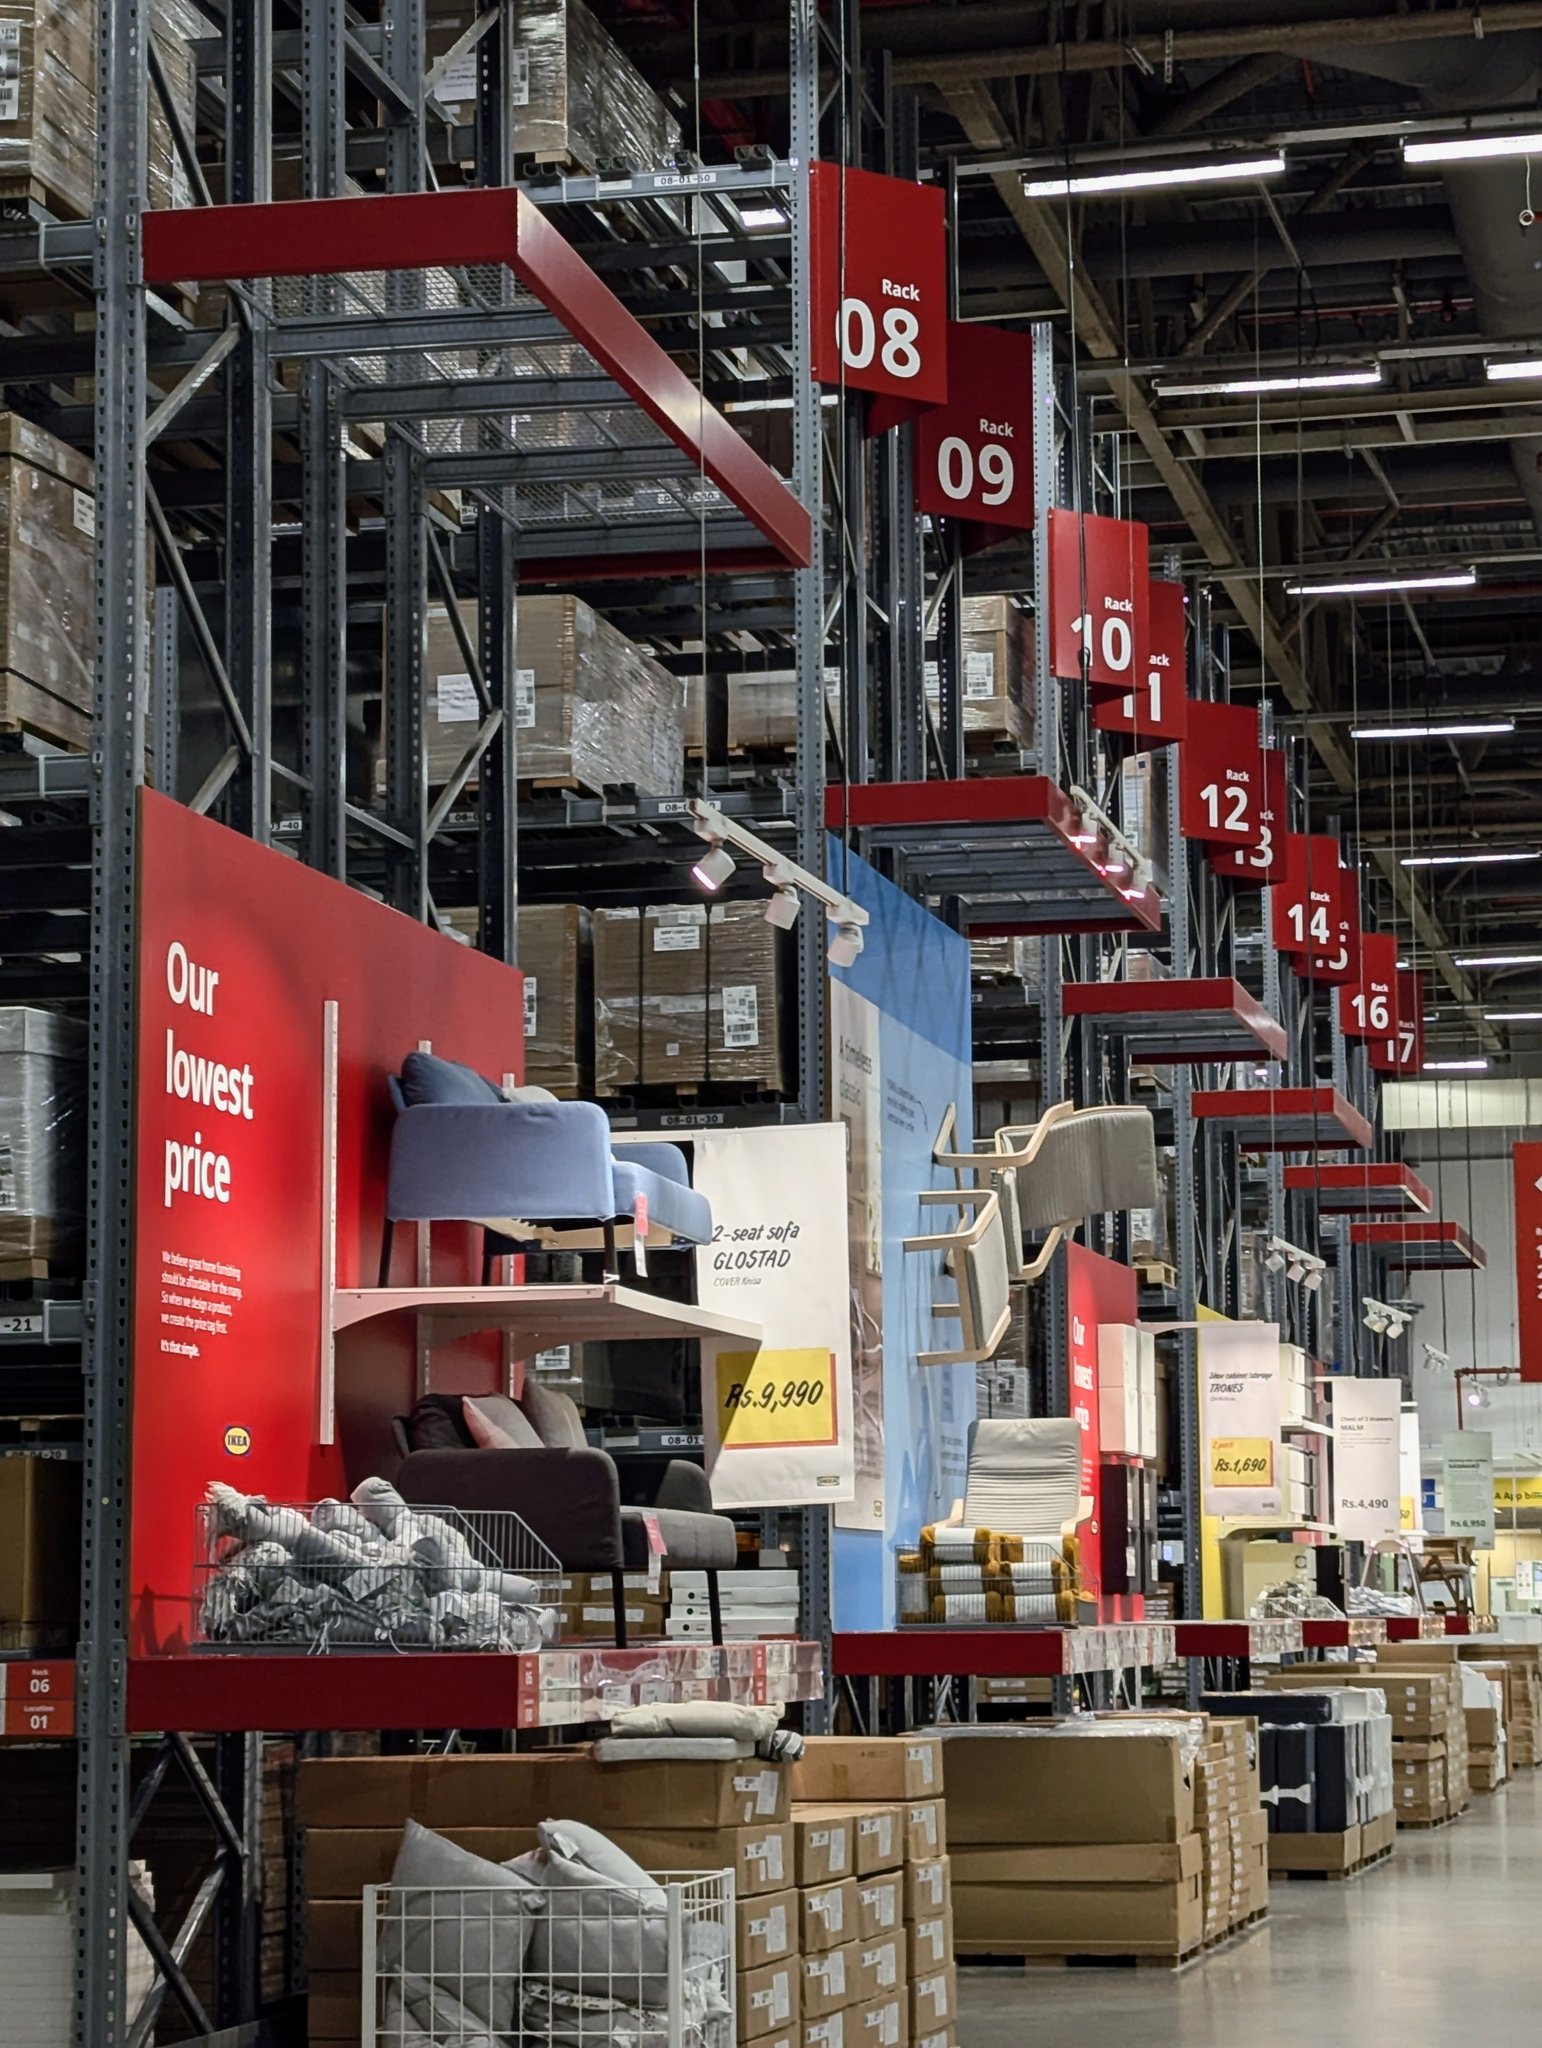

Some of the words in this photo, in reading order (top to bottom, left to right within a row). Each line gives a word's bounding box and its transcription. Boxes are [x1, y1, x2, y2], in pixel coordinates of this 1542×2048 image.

[881, 277, 921, 302] Rack
[835, 297, 921, 379] 08
[979, 418, 1014, 438] Rack
[937, 436, 1014, 506] 09
[1104, 596, 1133, 613] Rack
[1070, 614, 1132, 672] 10
[1149, 653, 1170, 667] ack
[1226, 769, 1250, 783] Rack
[1200, 784, 1249, 832] 12
[1310, 891, 1331, 903] Rack
[1287, 903, 1331, 945] 14
[166, 941, 219, 1017] Our
[1371, 982, 1389, 993] Rack
[1351, 994, 1389, 1030] 16
[1387, 1032, 1415, 1064] 17
[165, 1028, 254, 1121] lowest
[164, 1131, 231, 1208] price
[711, 1224, 765, 1242] 2-seat
[767, 1220, 801, 1243] sofa
[713, 1249, 791, 1271] GLOSTAD
[713, 1276, 741, 1287] COVER
[724, 1379, 824, 1414] Rs.9,990
[1209, 1382, 1245, 1394] TRONES
[227, 1433, 248, 1447] IKEA
[1214, 1457, 1267, 1476] Rs.1,690
[1341, 1498, 1389, 1509] Rs.4,490
[30, 1679, 50, 1693] 06
[30, 1714, 48, 1730] 01
